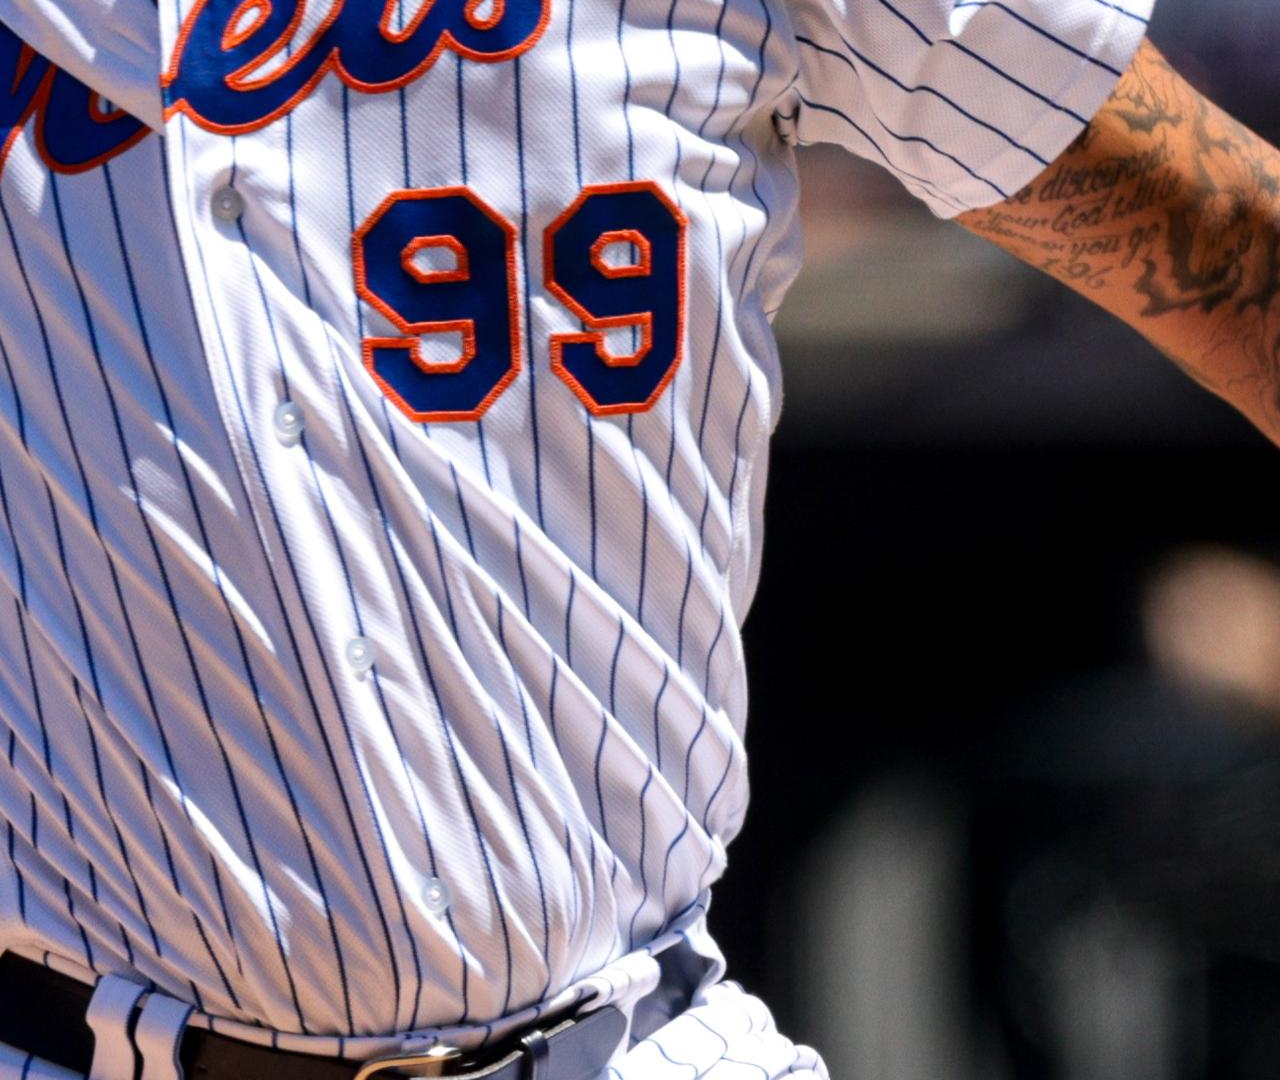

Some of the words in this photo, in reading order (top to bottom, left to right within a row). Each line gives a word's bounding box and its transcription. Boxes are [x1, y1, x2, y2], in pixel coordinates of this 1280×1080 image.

[352, 181, 687, 422] 99
[1070, 235, 1121, 262] you
[1122, 222, 1161, 268] go
